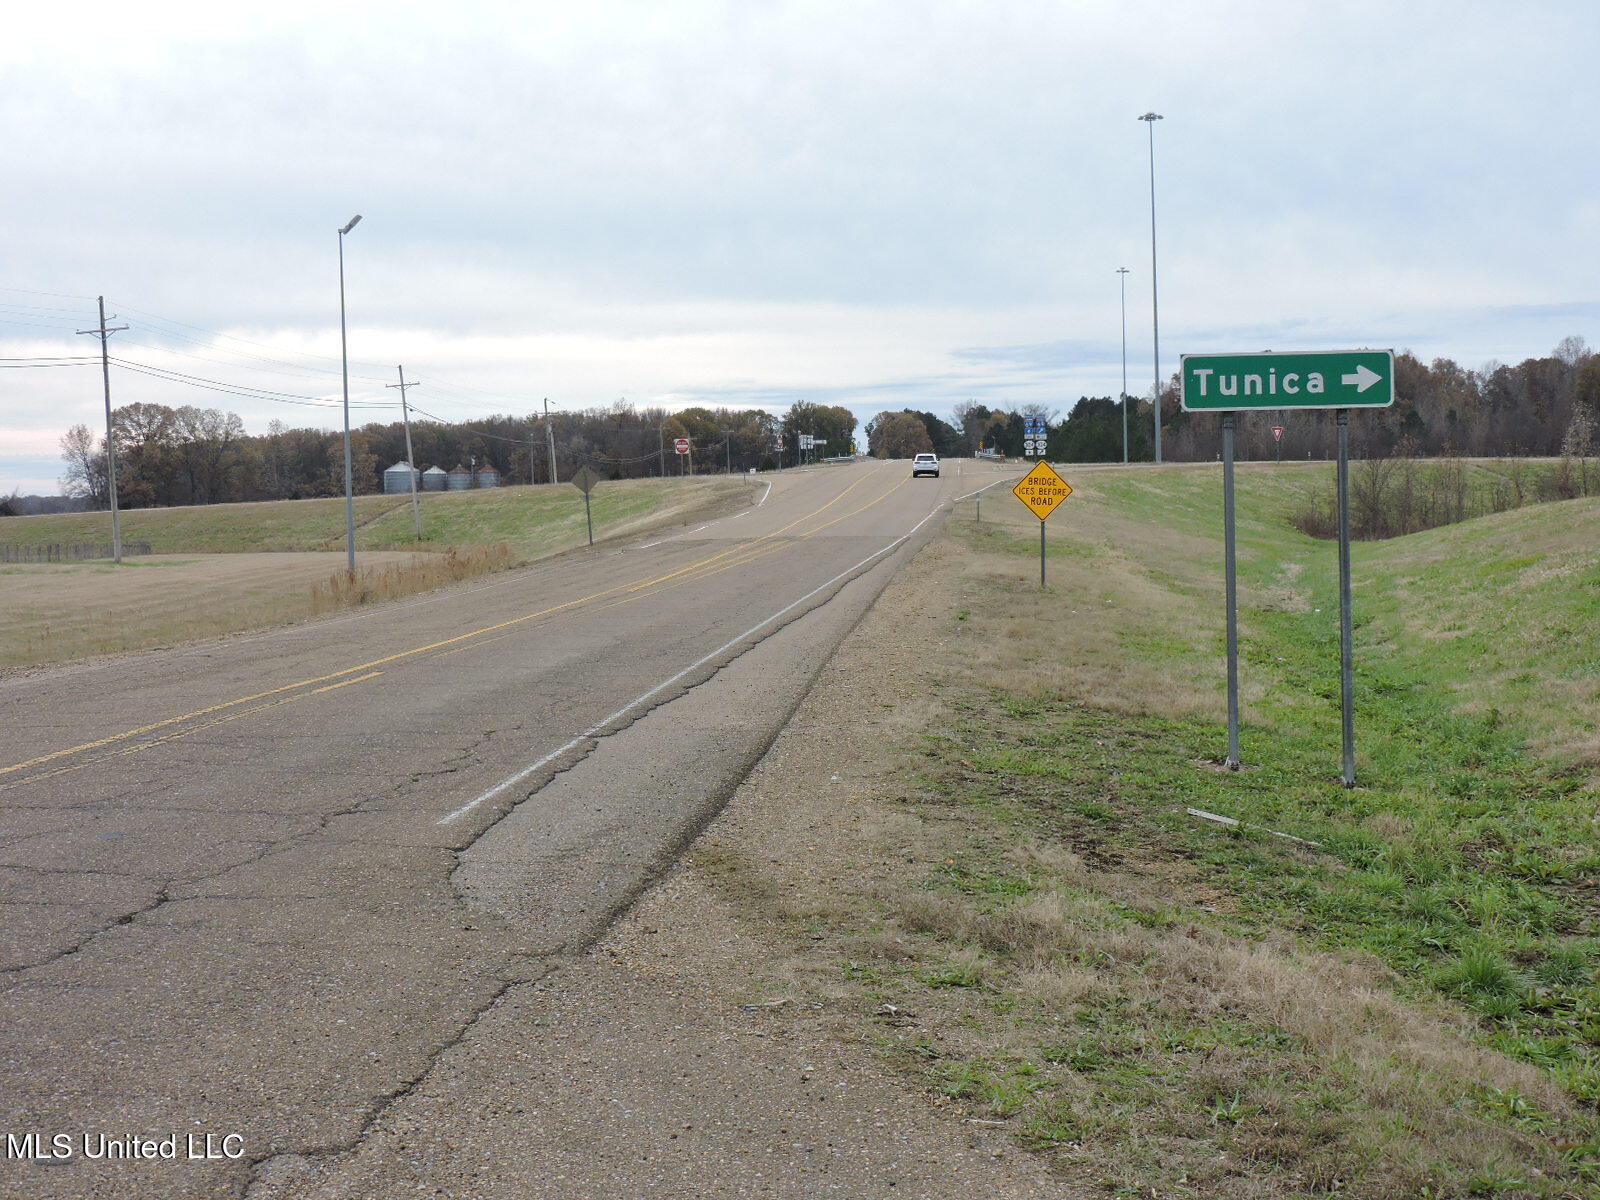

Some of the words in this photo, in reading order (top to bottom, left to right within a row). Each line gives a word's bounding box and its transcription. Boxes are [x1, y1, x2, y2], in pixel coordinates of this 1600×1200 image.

[1193, 367, 1325, 396] Tunica
[1028, 478, 1057, 486] BRIDGE
[1038, 488, 1067, 496] BEFORE
[1030, 497, 1053, 506] ROAD
